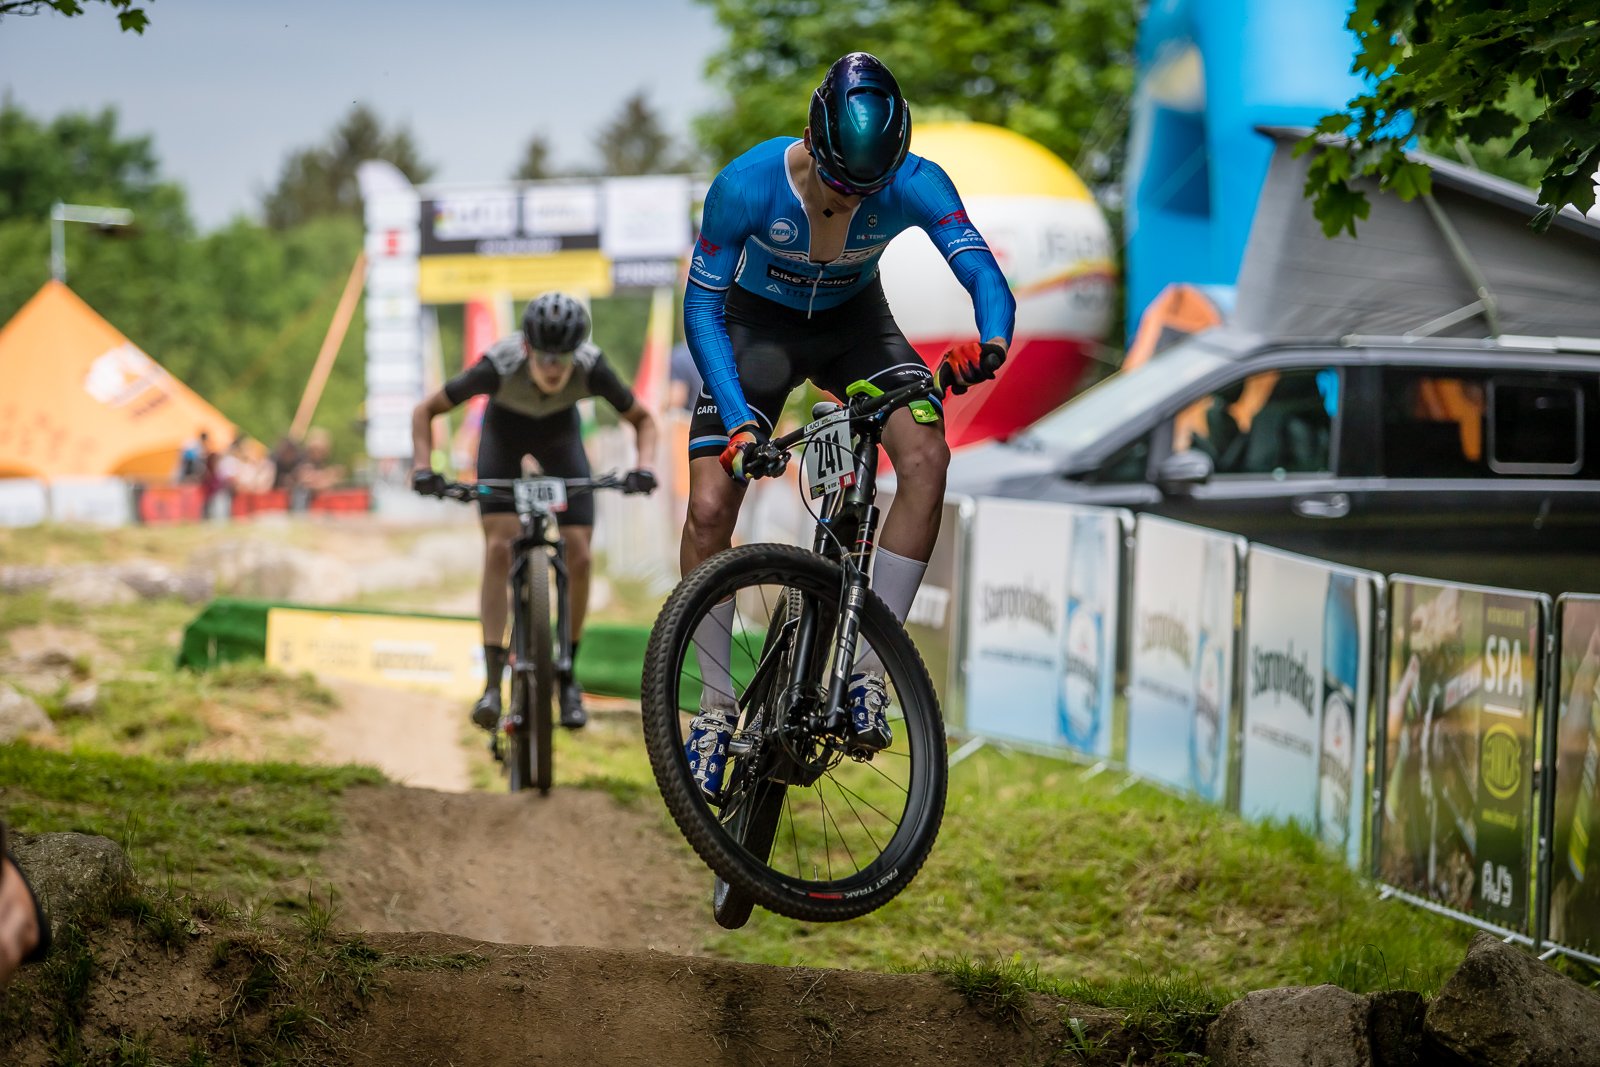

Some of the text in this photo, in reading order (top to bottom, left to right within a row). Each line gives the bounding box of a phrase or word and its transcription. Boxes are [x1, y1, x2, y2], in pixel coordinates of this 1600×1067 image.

[770, 268, 801, 284] bike
[813, 430, 843, 479] 241
[1484, 634, 1523, 698] SPA
[875, 868, 899, 890] FAST
[843, 885, 874, 900] TRAK
